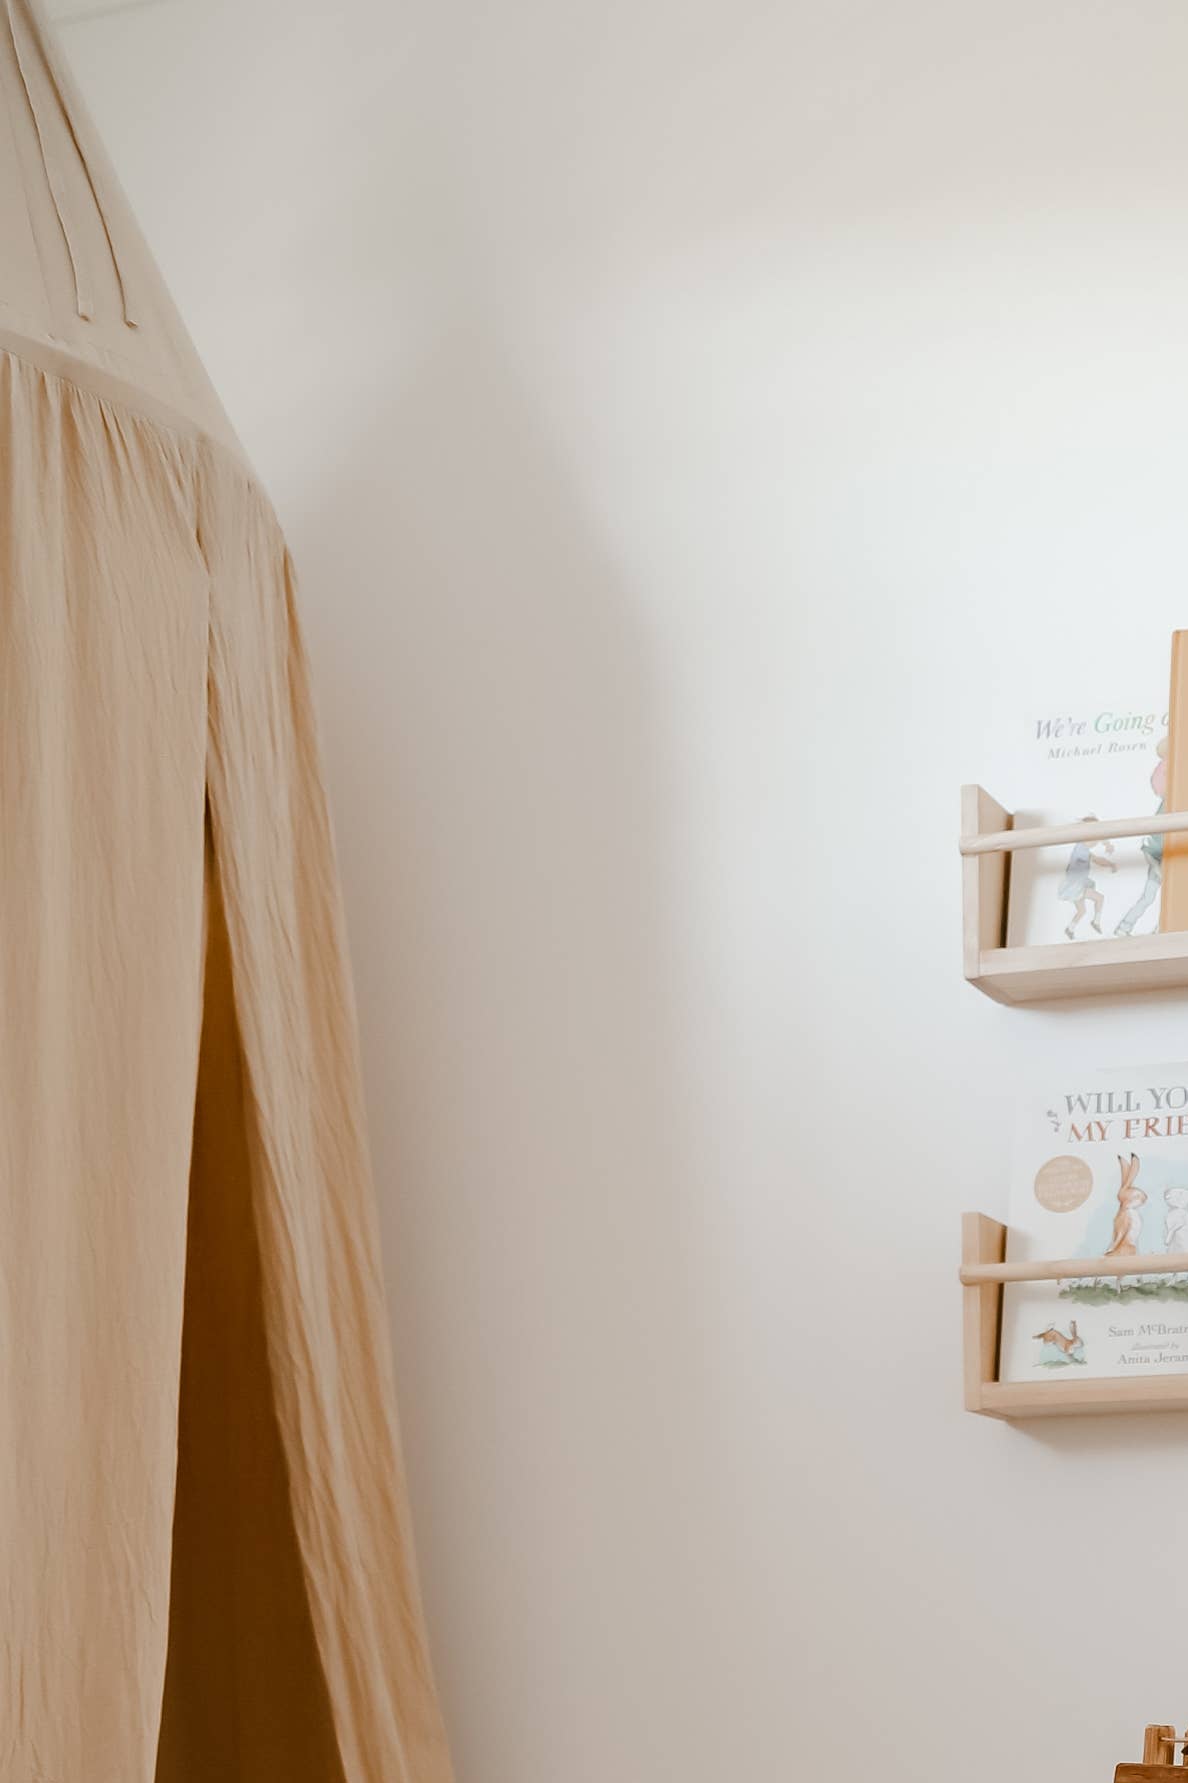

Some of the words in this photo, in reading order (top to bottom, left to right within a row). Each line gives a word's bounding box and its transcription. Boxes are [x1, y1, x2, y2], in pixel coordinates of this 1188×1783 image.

[1034, 716, 1087, 740] We're
[1094, 712, 1156, 735] Going
[1048, 744, 1103, 759] Michael
[1108, 741, 1147, 753] Rosen
[1064, 1090, 1141, 1115] WILL
[1068, 1120, 1113, 1143] MY
[1108, 1326, 1134, 1337] Sam
[1118, 1354, 1150, 1364] Anita
